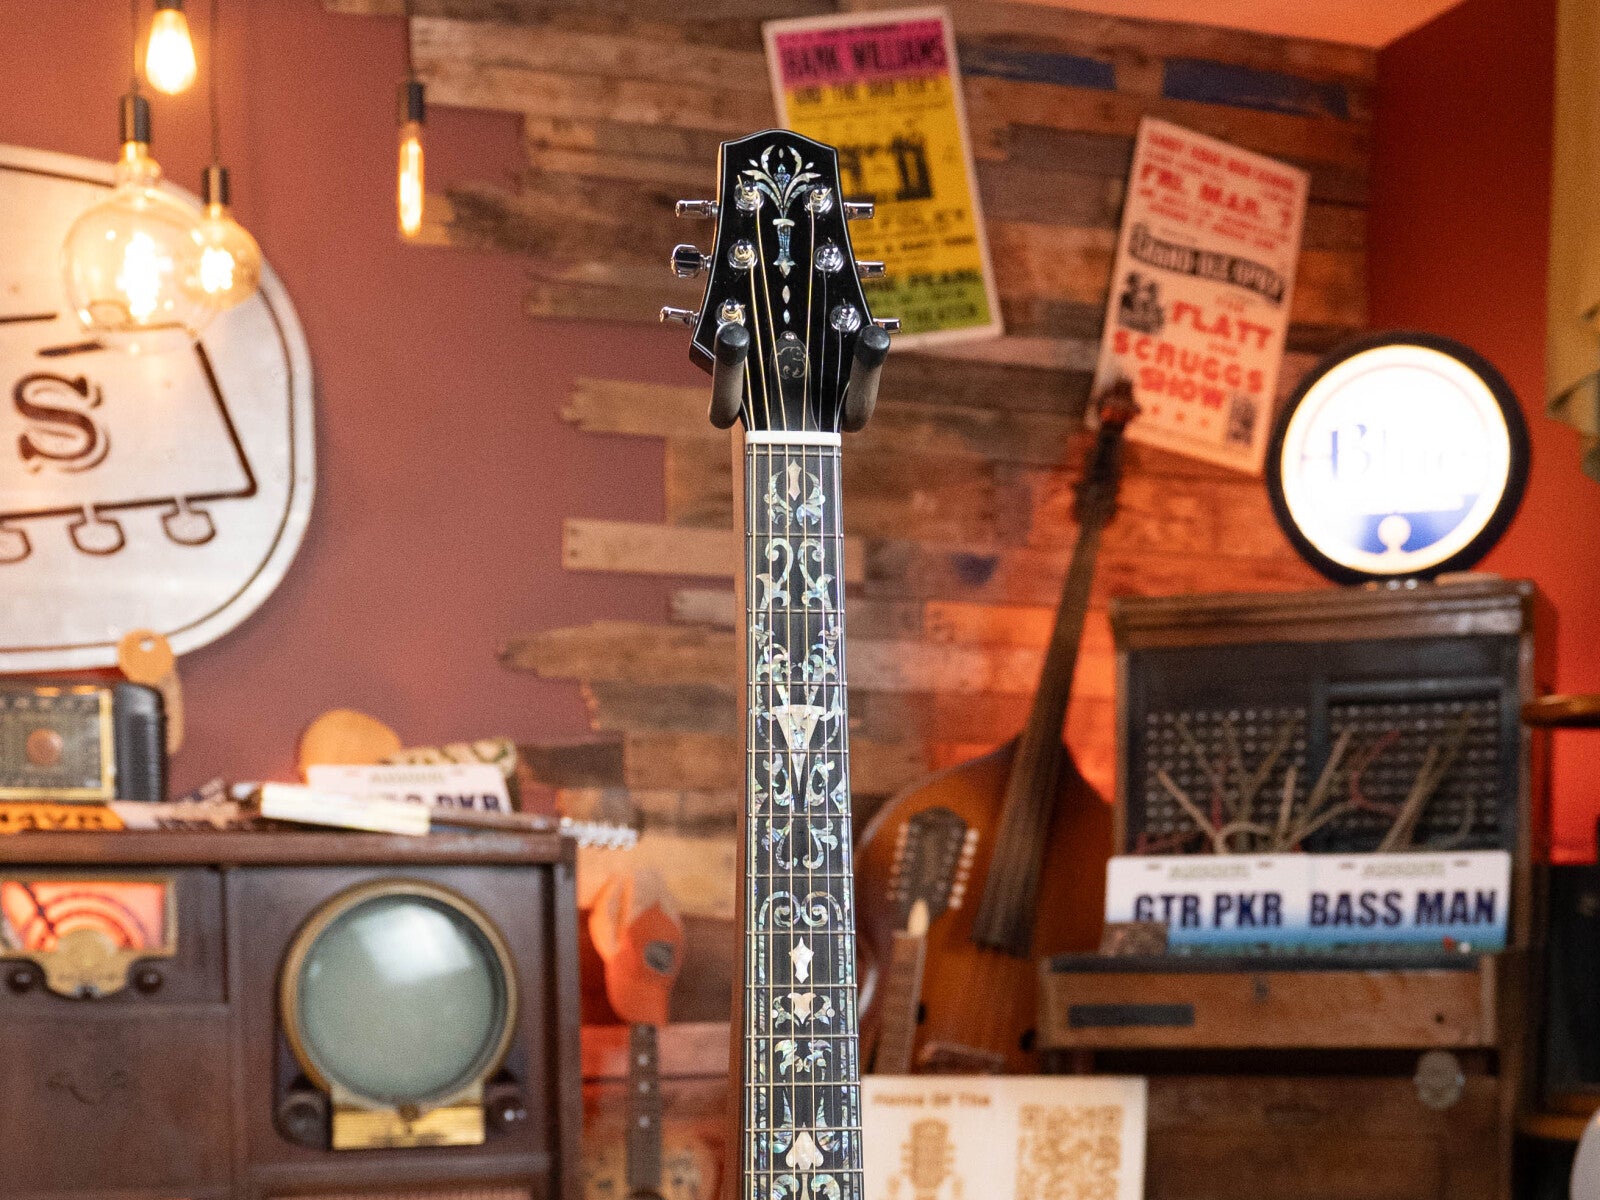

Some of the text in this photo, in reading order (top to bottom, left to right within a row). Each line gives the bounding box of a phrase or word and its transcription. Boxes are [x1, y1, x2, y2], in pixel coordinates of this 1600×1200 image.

[1172, 301, 1274, 350] FLATT
[1113, 330, 1265, 395] SCRUGGS
[1135, 892, 1282, 928] GTR PKR
[1310, 888, 1497, 927] BASS MAN
